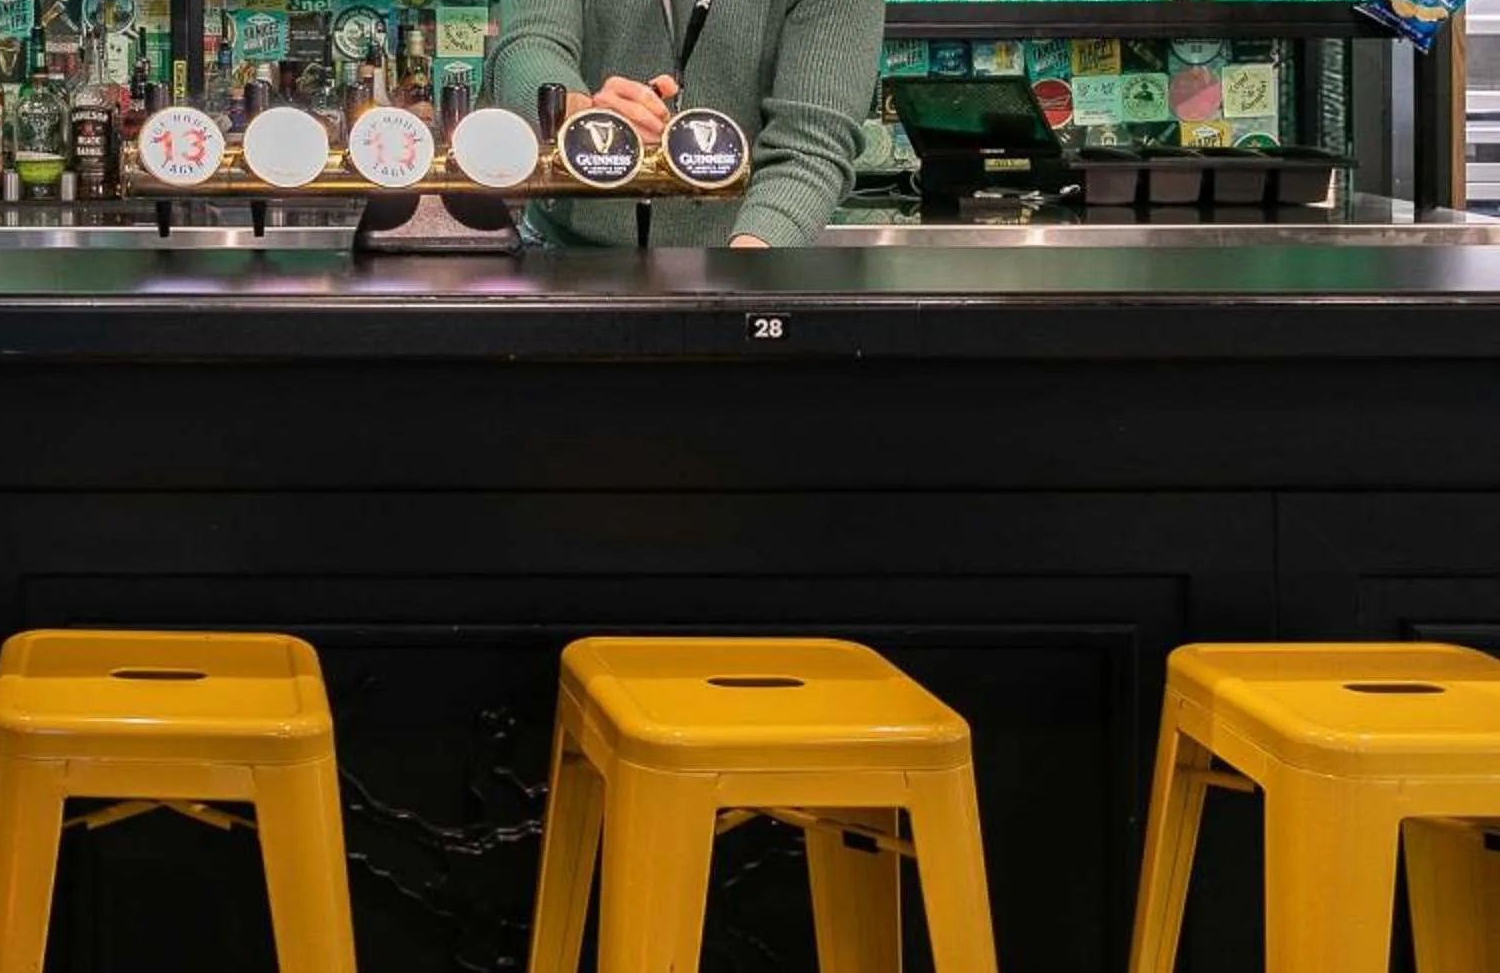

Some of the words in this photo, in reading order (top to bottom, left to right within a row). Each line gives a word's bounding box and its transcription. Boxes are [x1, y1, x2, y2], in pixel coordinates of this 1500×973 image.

[156, 130, 206, 162] 13
[575, 154, 632, 166] GUINNESS
[679, 154, 736, 166] GUINNESS
[754, 318, 783, 338] 28
